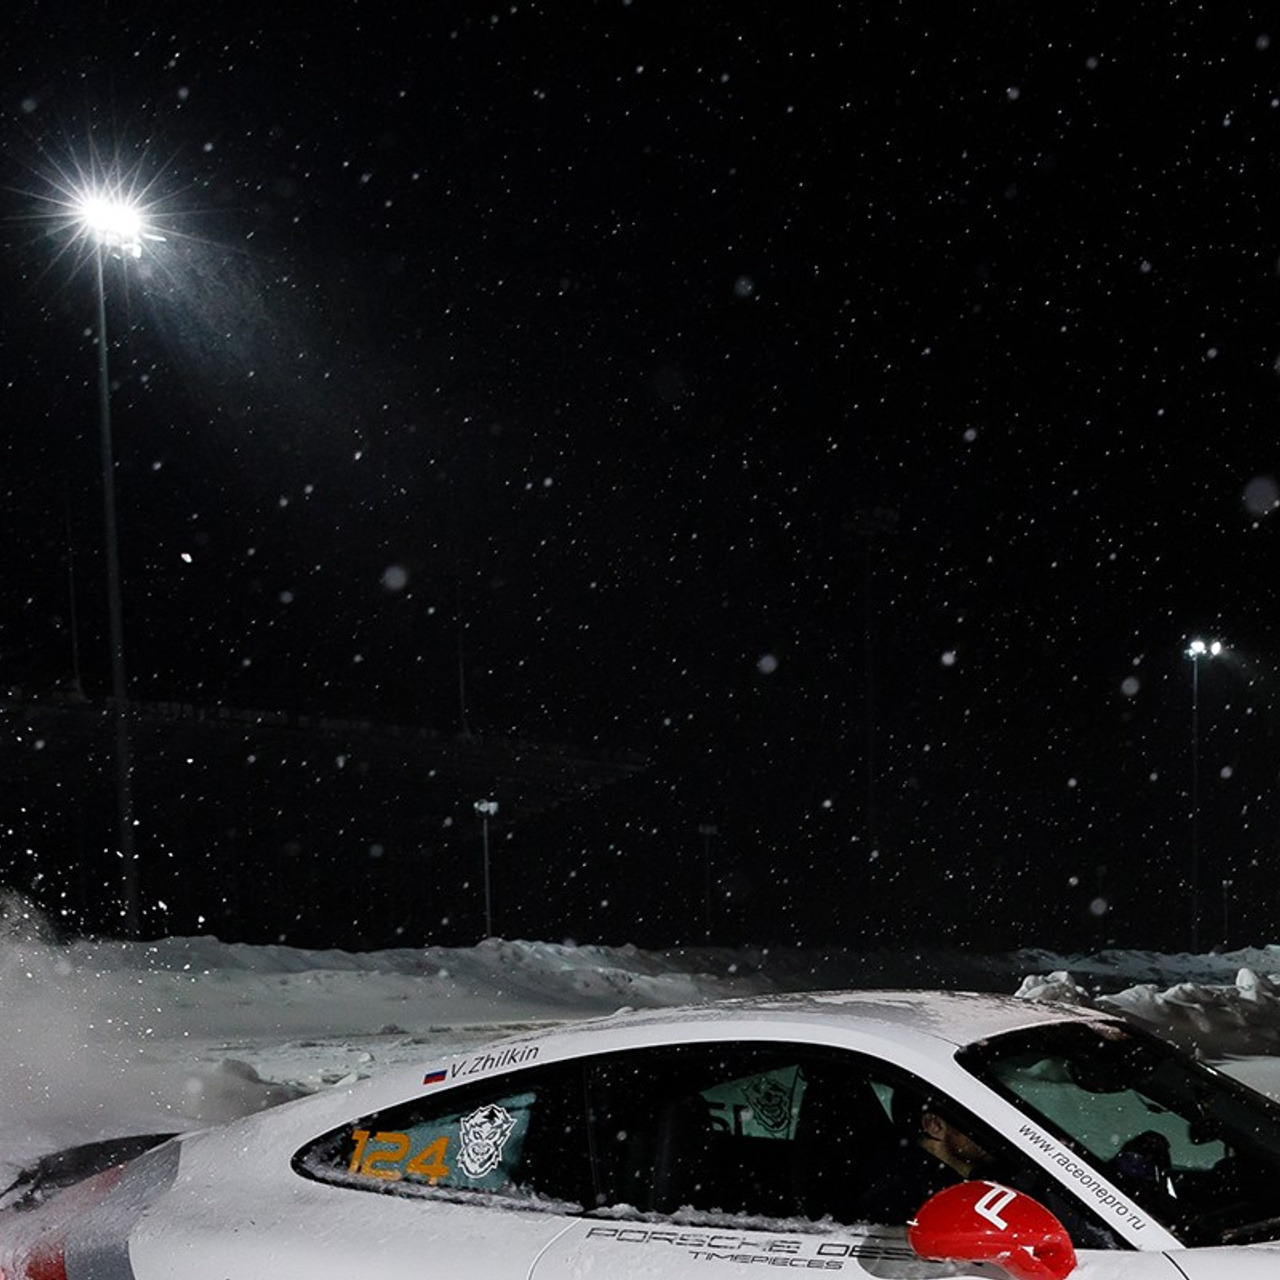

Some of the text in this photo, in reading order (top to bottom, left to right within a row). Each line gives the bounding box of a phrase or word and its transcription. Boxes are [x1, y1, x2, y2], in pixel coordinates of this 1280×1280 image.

[451, 1045, 539, 1078] V.Zhilkin
[349, 1129, 449, 1186] 124
[1018, 1123, 1147, 1231] www.raceonepro.ru
[586, 1227, 802, 1254] PORSCHE
[688, 1250, 844, 1270] TIMEPIECES
